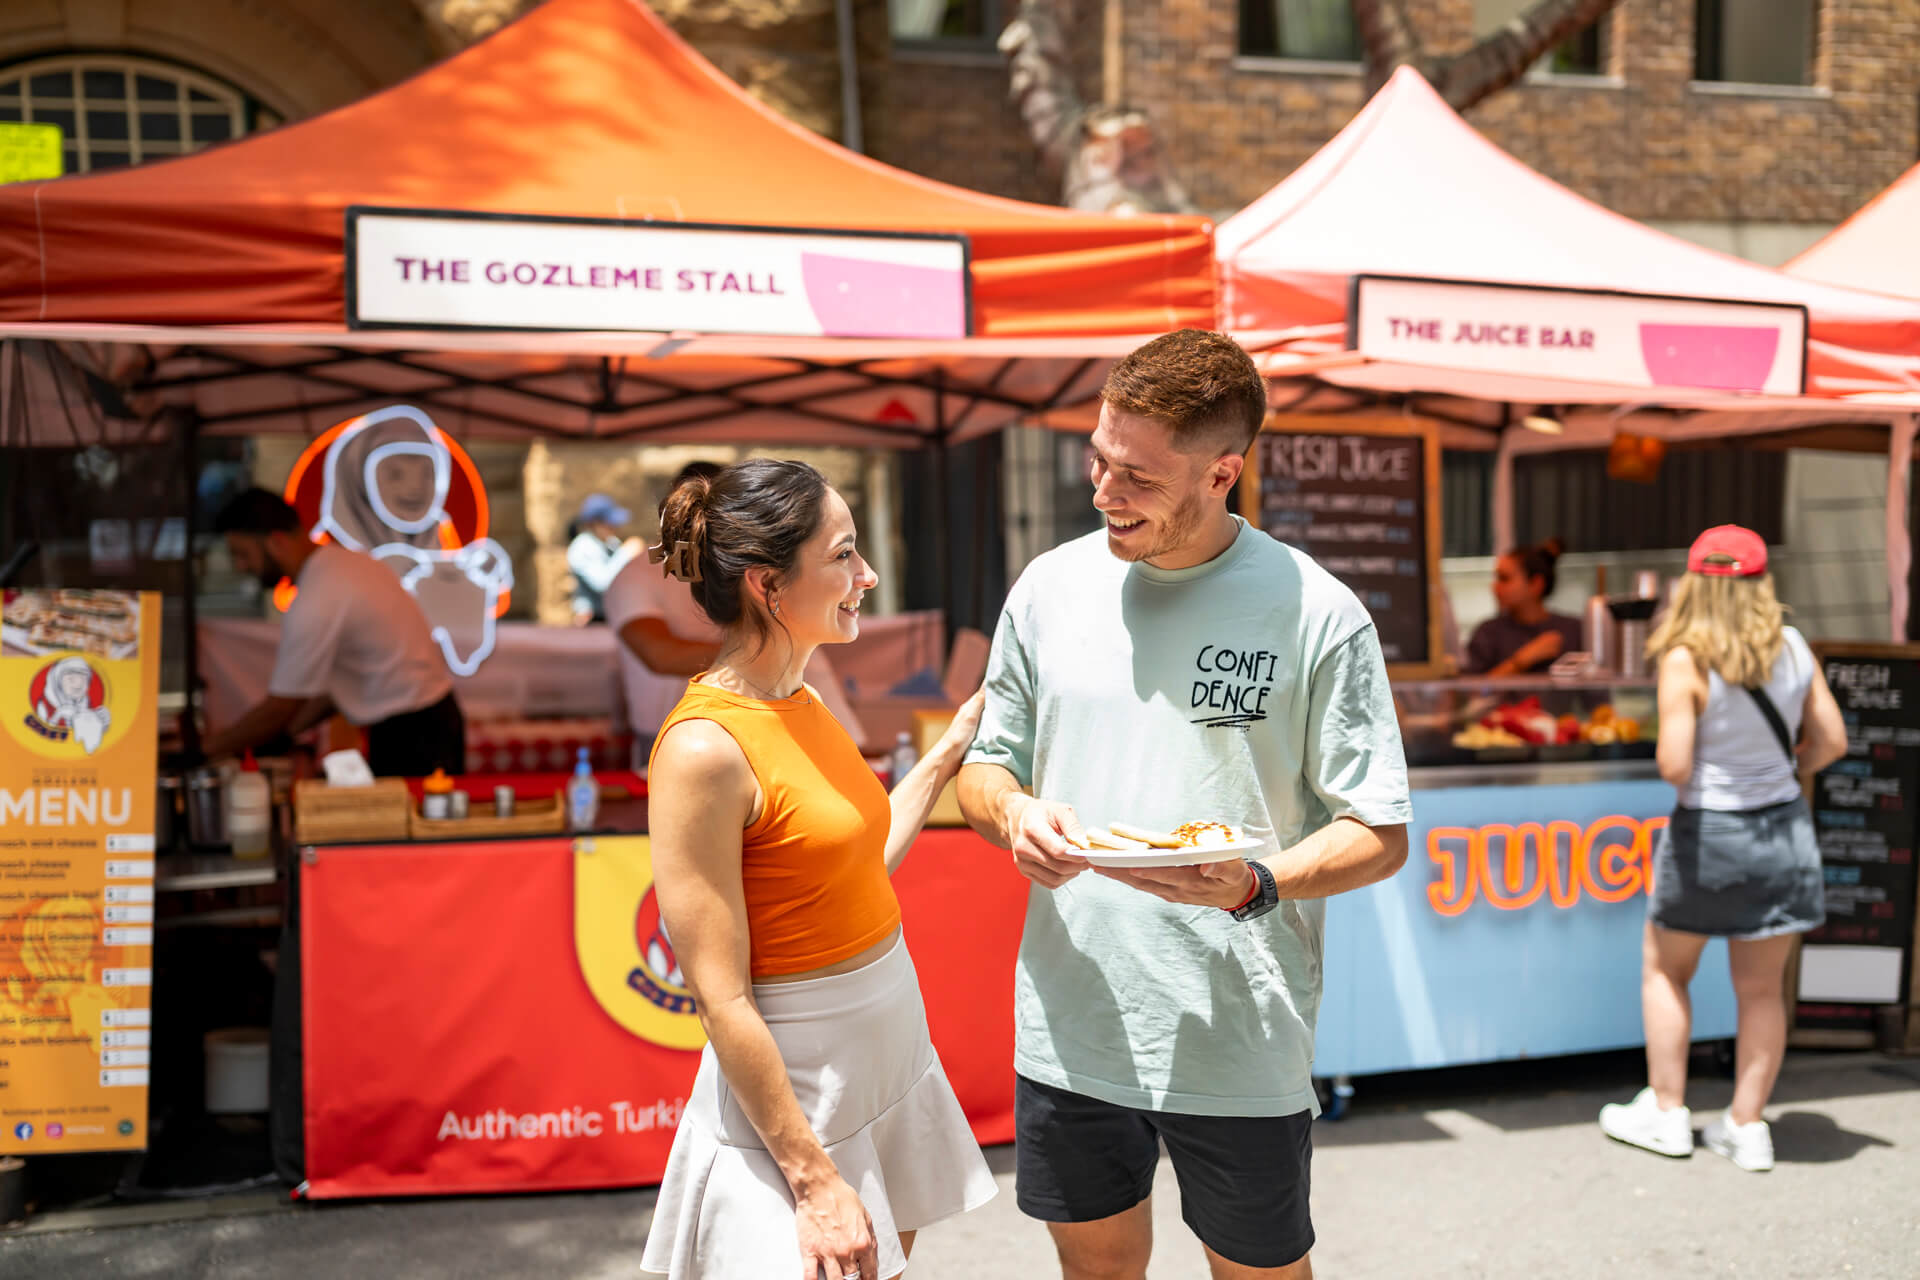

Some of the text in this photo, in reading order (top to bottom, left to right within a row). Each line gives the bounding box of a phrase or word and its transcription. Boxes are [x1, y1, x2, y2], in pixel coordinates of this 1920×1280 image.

[394, 256, 785, 296] THE GOZLEME STALL
[1388, 318, 1595, 350] THE JUICE BAR
[1196, 644, 1278, 682] CONFI
[1191, 680, 1271, 714] DENCE
[0, 788, 132, 827] MENU
[437, 1107, 604, 1142] Authentic
